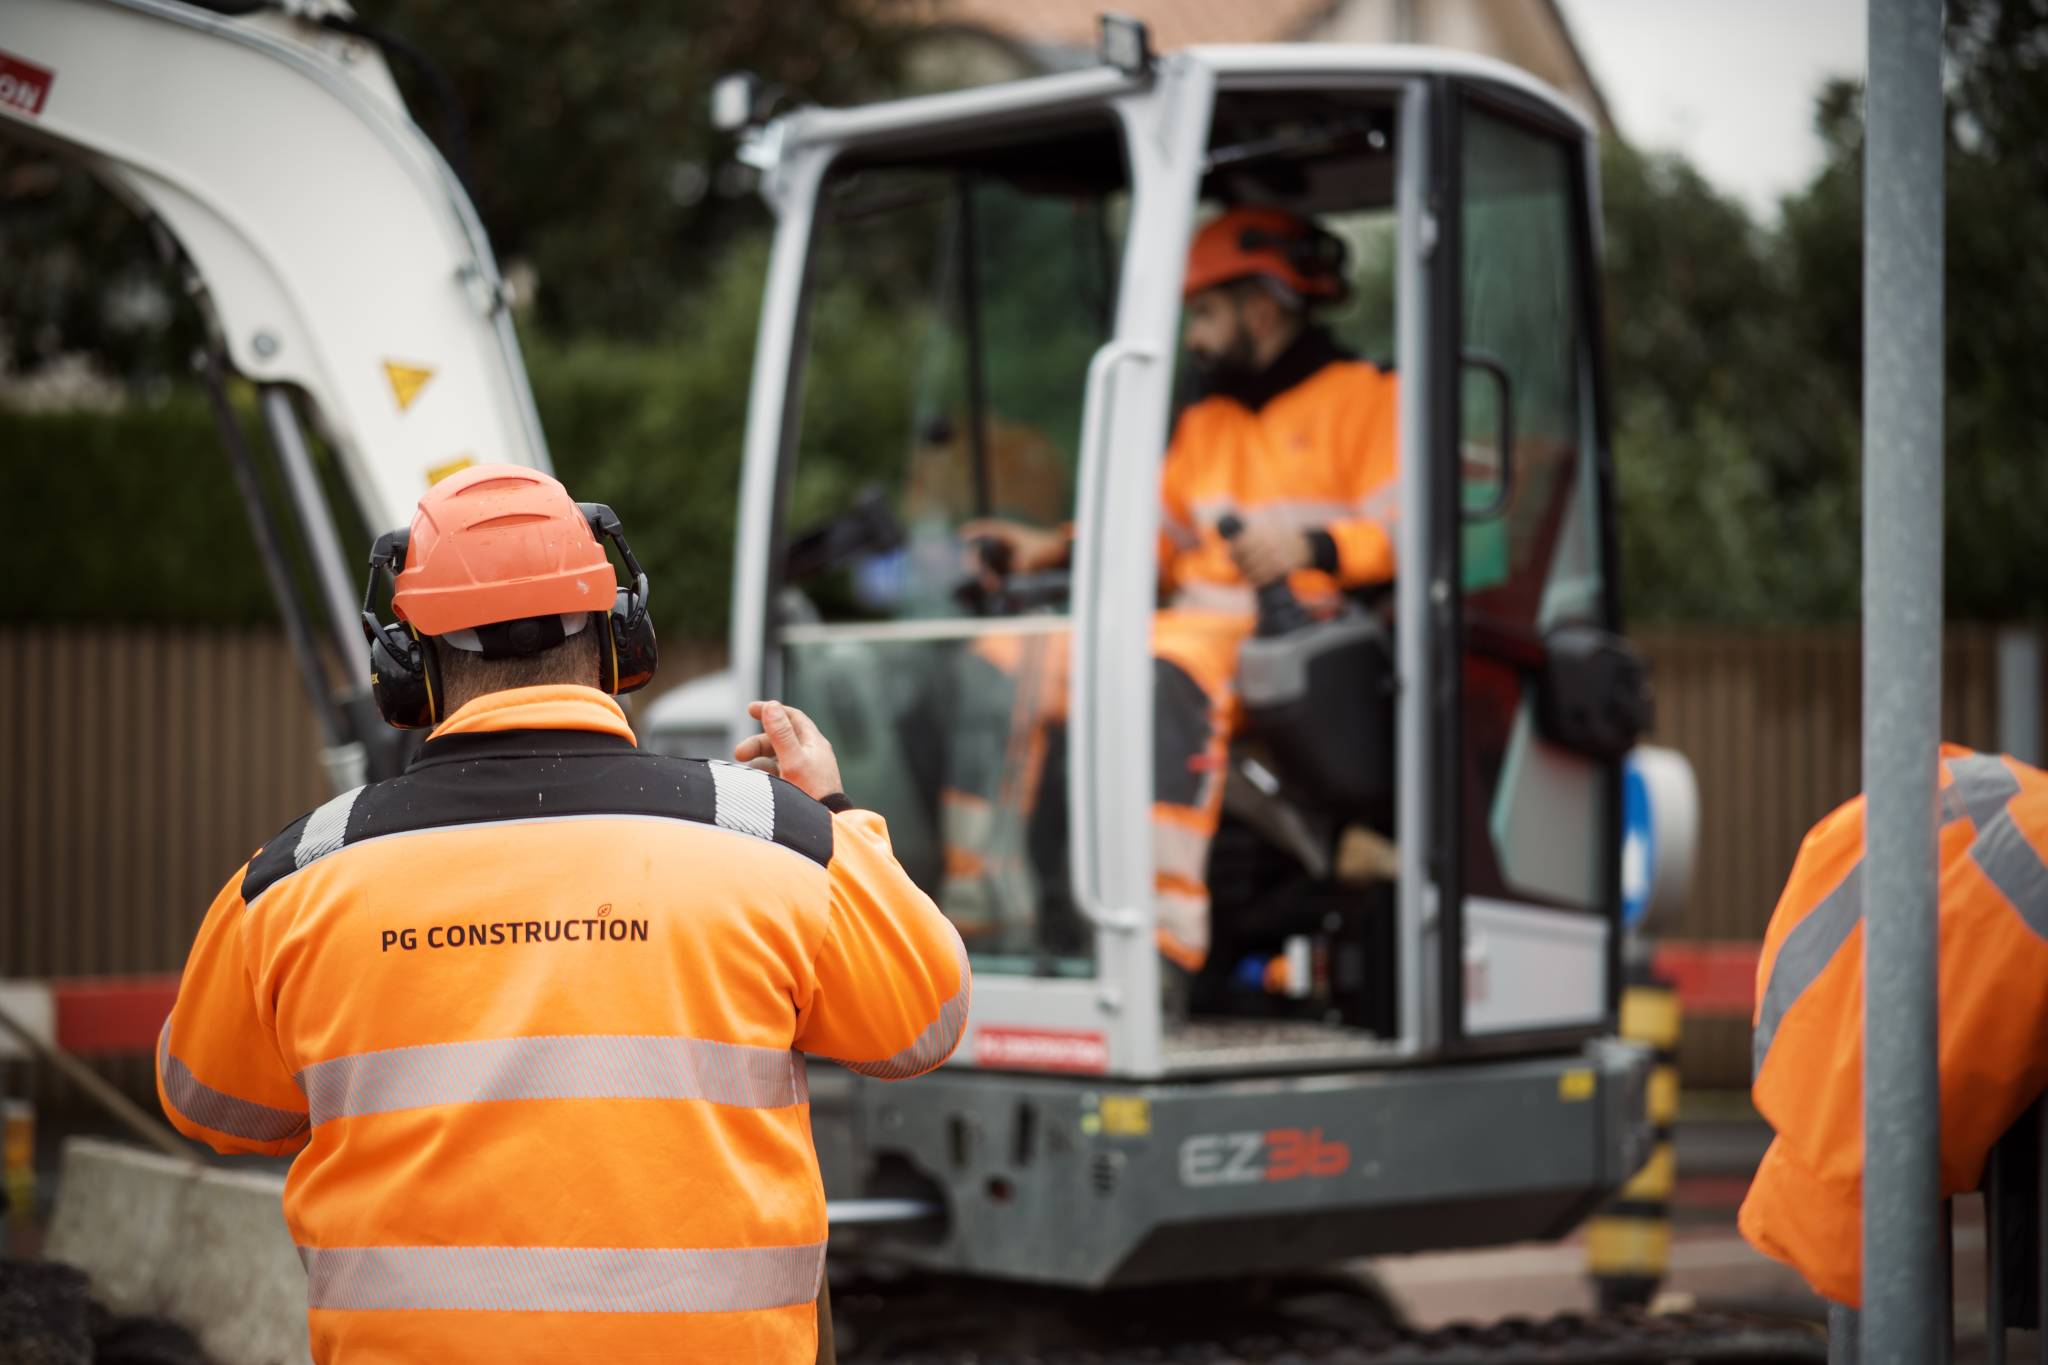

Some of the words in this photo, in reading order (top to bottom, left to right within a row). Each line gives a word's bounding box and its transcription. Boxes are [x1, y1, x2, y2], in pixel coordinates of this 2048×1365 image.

[382, 928, 417, 952] PG
[428, 919, 649, 949] CONSTRUCTION
[1179, 1127, 1350, 1186] EZ36
